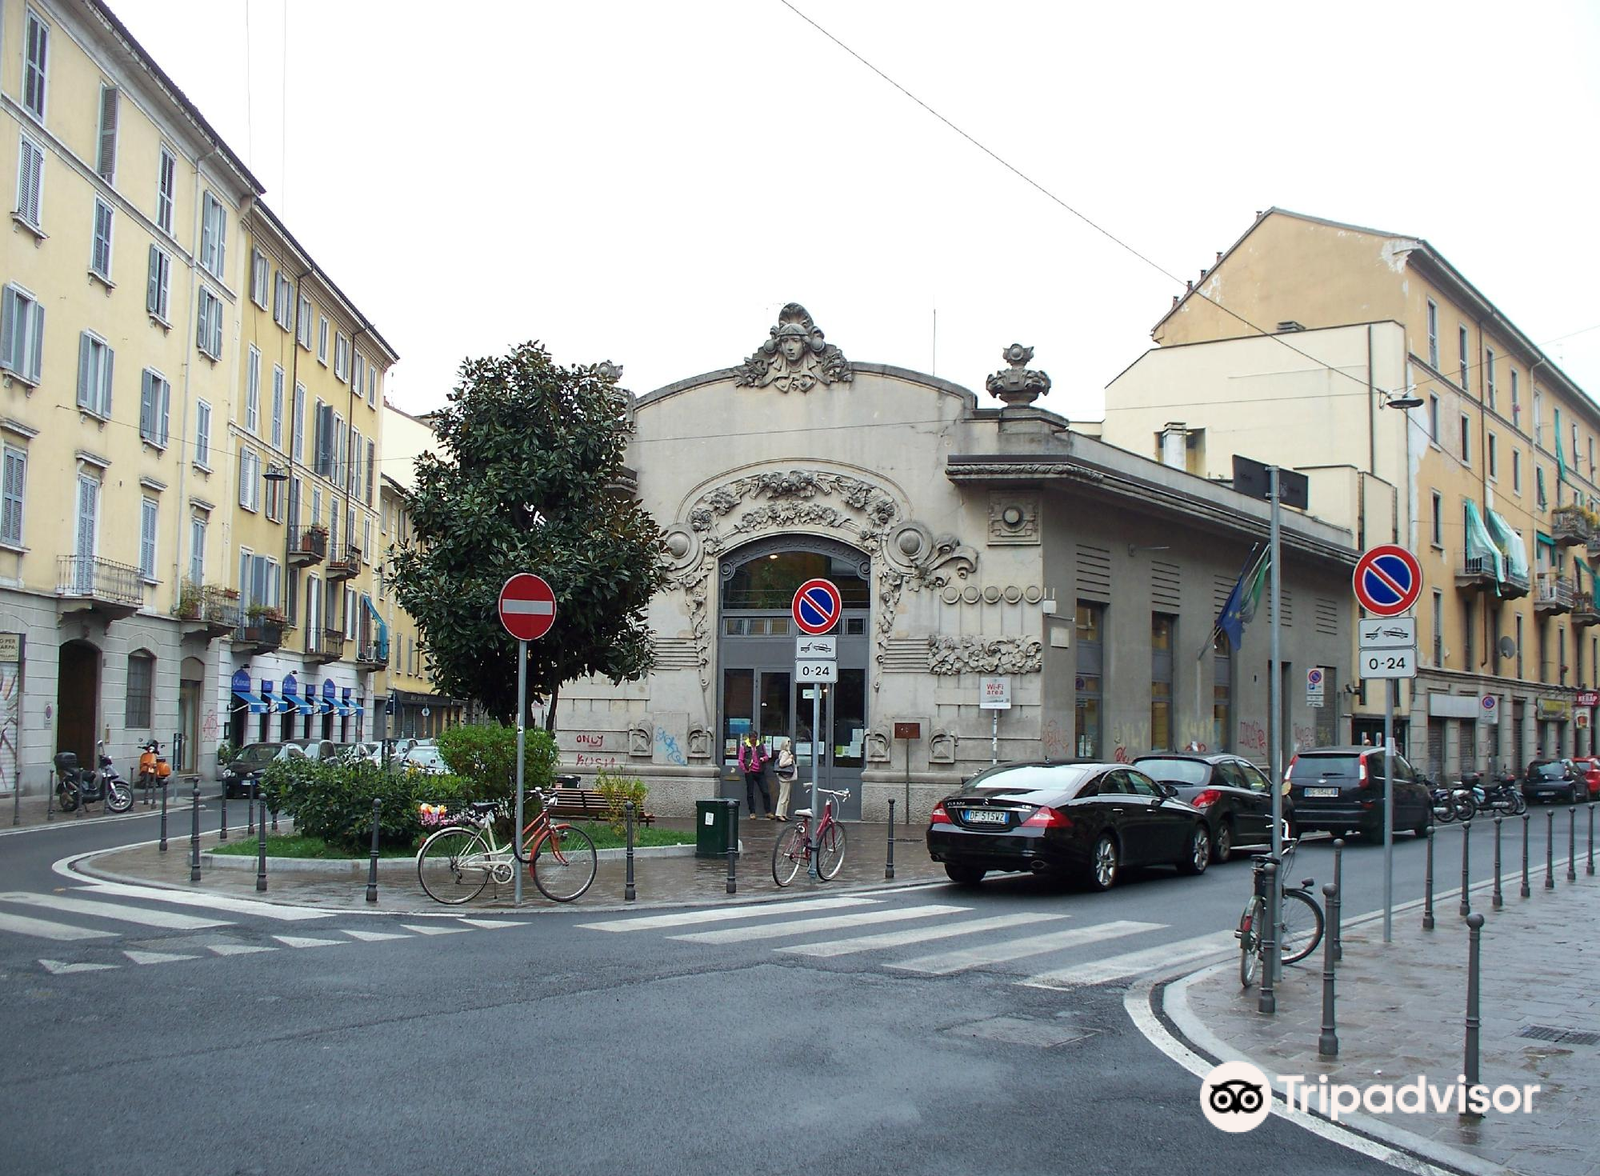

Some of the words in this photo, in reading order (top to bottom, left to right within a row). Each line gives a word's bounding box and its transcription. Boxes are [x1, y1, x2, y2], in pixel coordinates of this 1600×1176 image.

[1369, 657, 1406, 670] 0-24
[802, 666, 830, 677] 0-24
[576, 735, 604, 748] ONLY
[970, 811, 979, 820] DF
